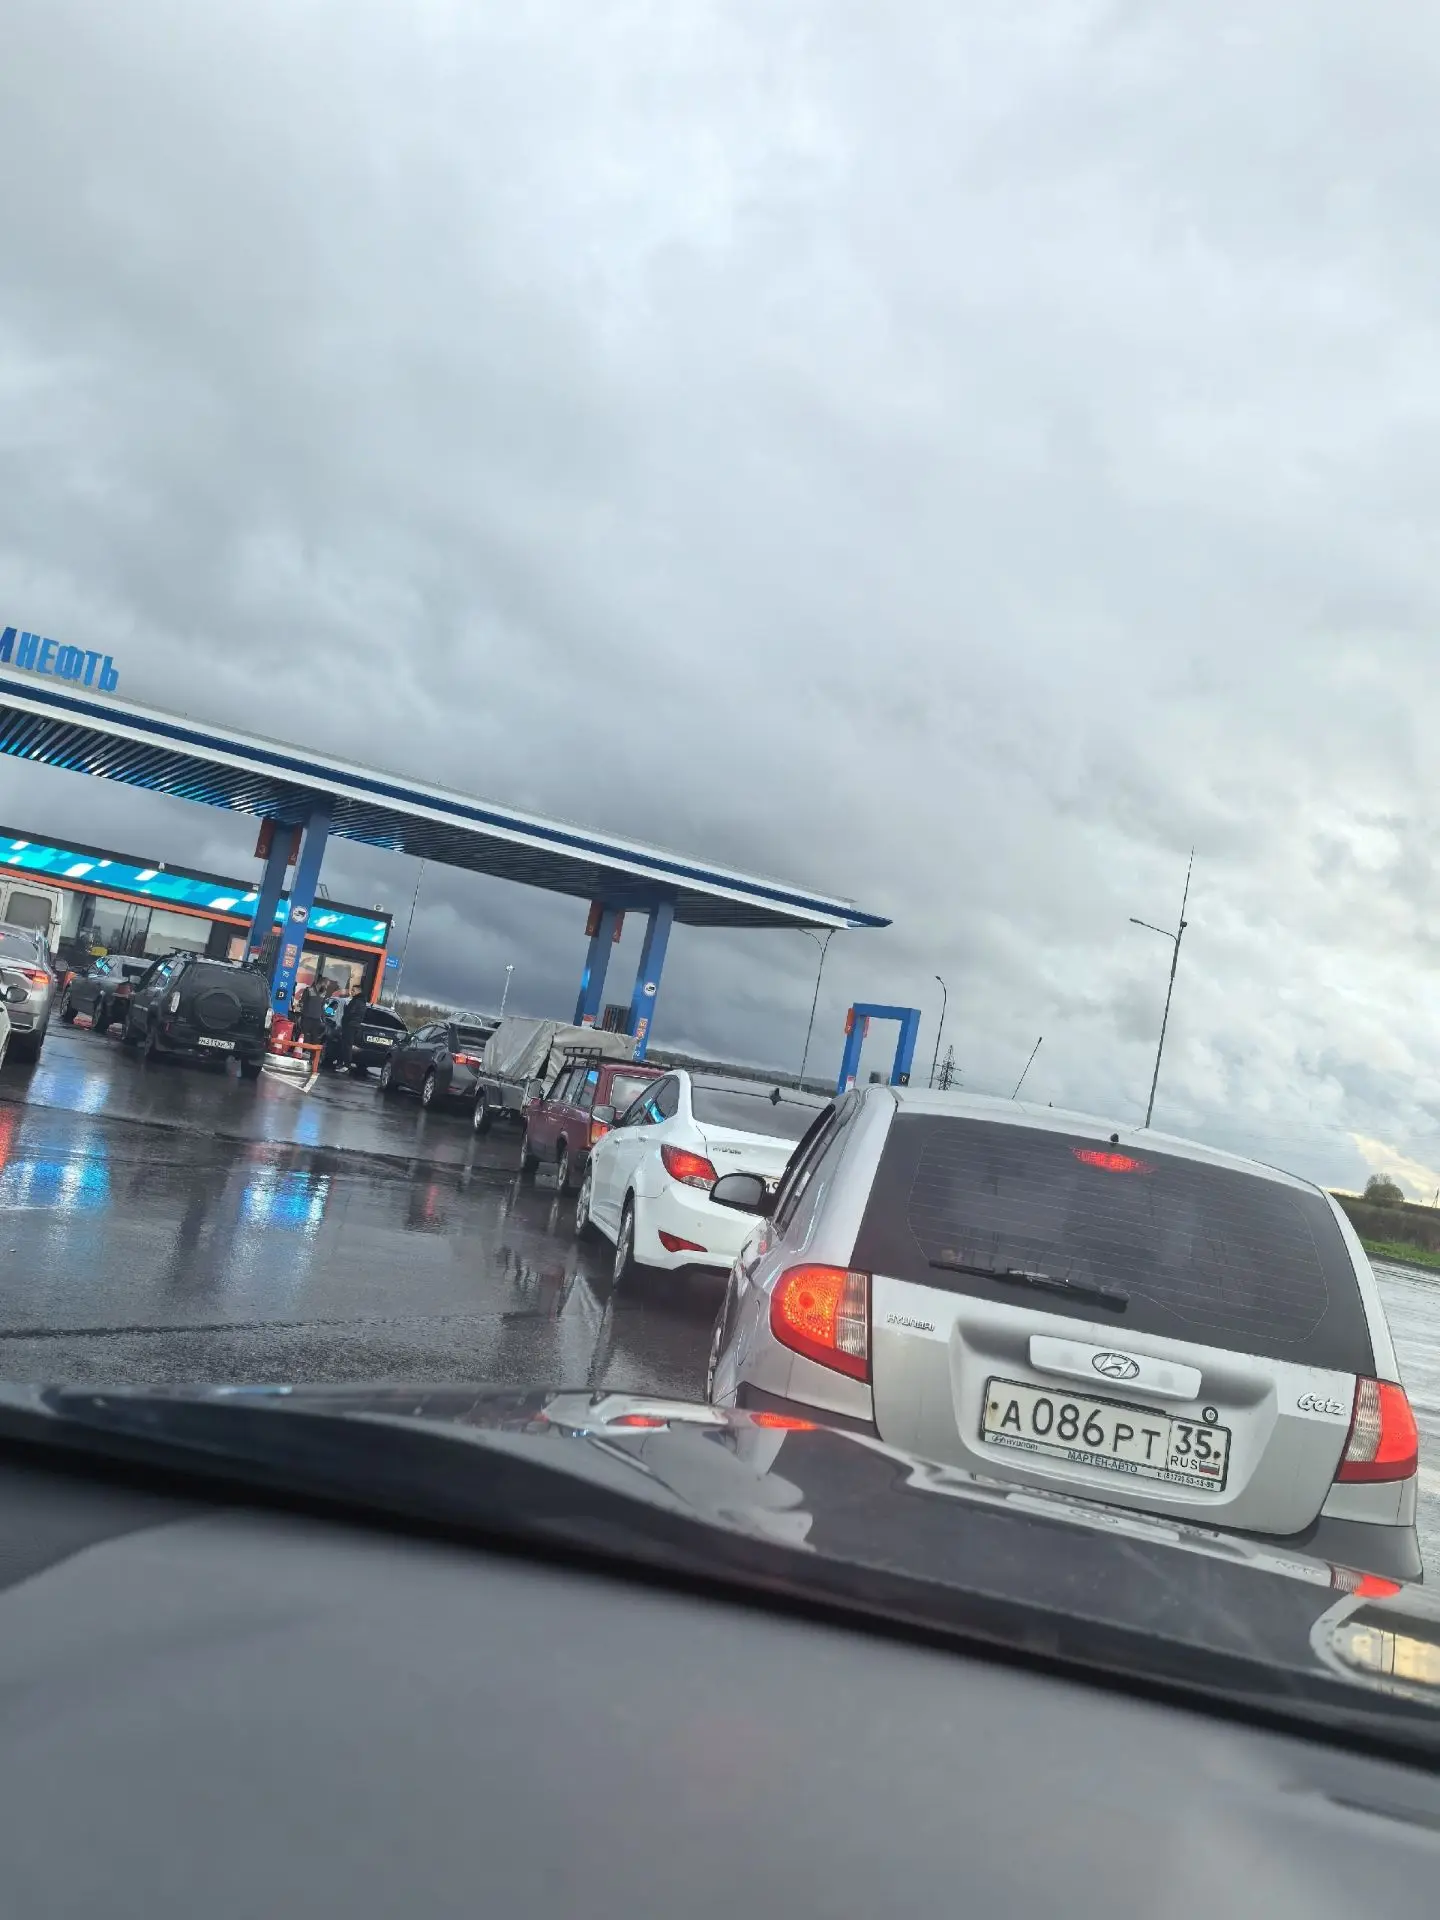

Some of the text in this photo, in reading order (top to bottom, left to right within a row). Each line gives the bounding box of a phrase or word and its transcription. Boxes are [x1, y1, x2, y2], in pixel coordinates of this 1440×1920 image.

[886, 1312, 935, 1332] HYUNDAI
[1297, 1392, 1345, 1415] Getz
[1175, 1424, 1213, 1460] 35
[1067, 1450, 1138, 1473] МАРТЕН-АВТО
[1171, 1455, 1198, 1470] RUS
